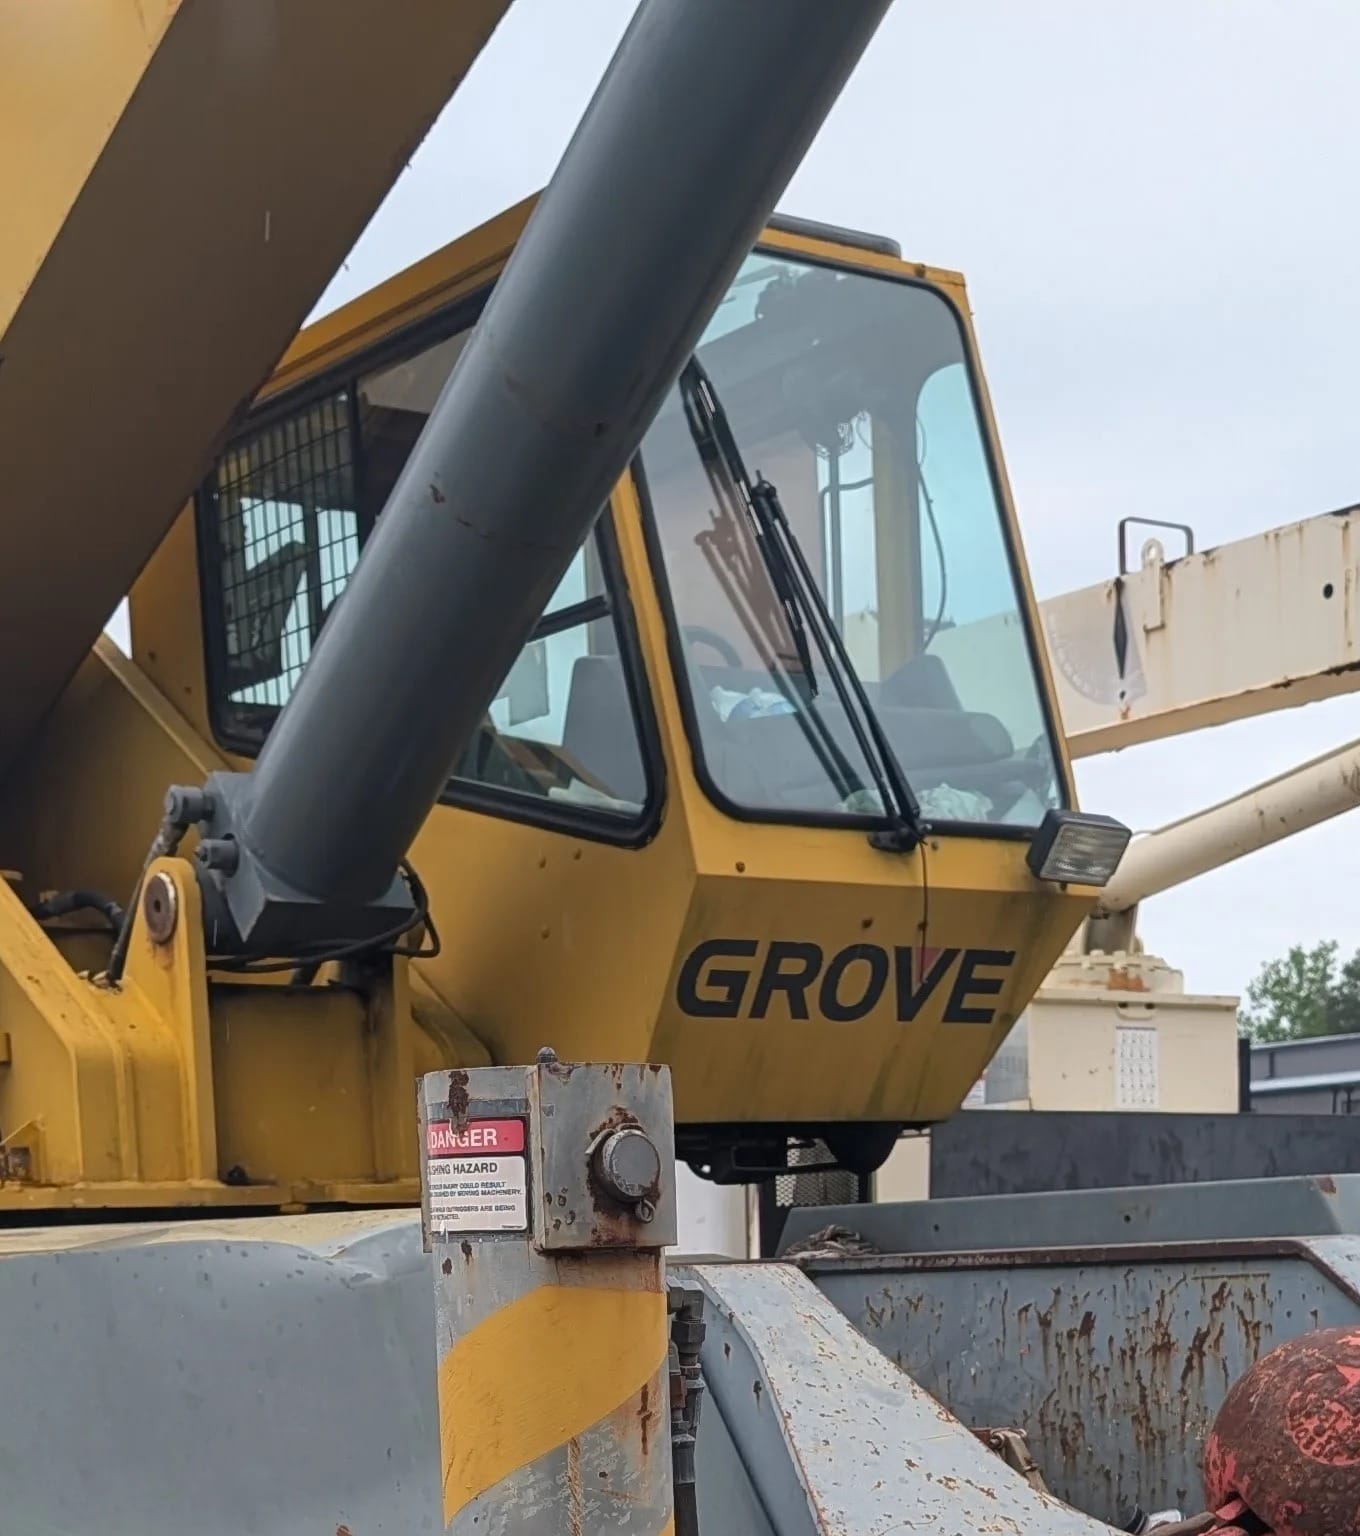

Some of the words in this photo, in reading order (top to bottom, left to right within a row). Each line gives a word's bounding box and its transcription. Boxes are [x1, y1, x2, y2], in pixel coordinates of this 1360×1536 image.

[676, 938, 1016, 1025] GROVE
[431, 1128, 498, 1149] DANGER
[453, 1162, 498, 1174] HAZARD
